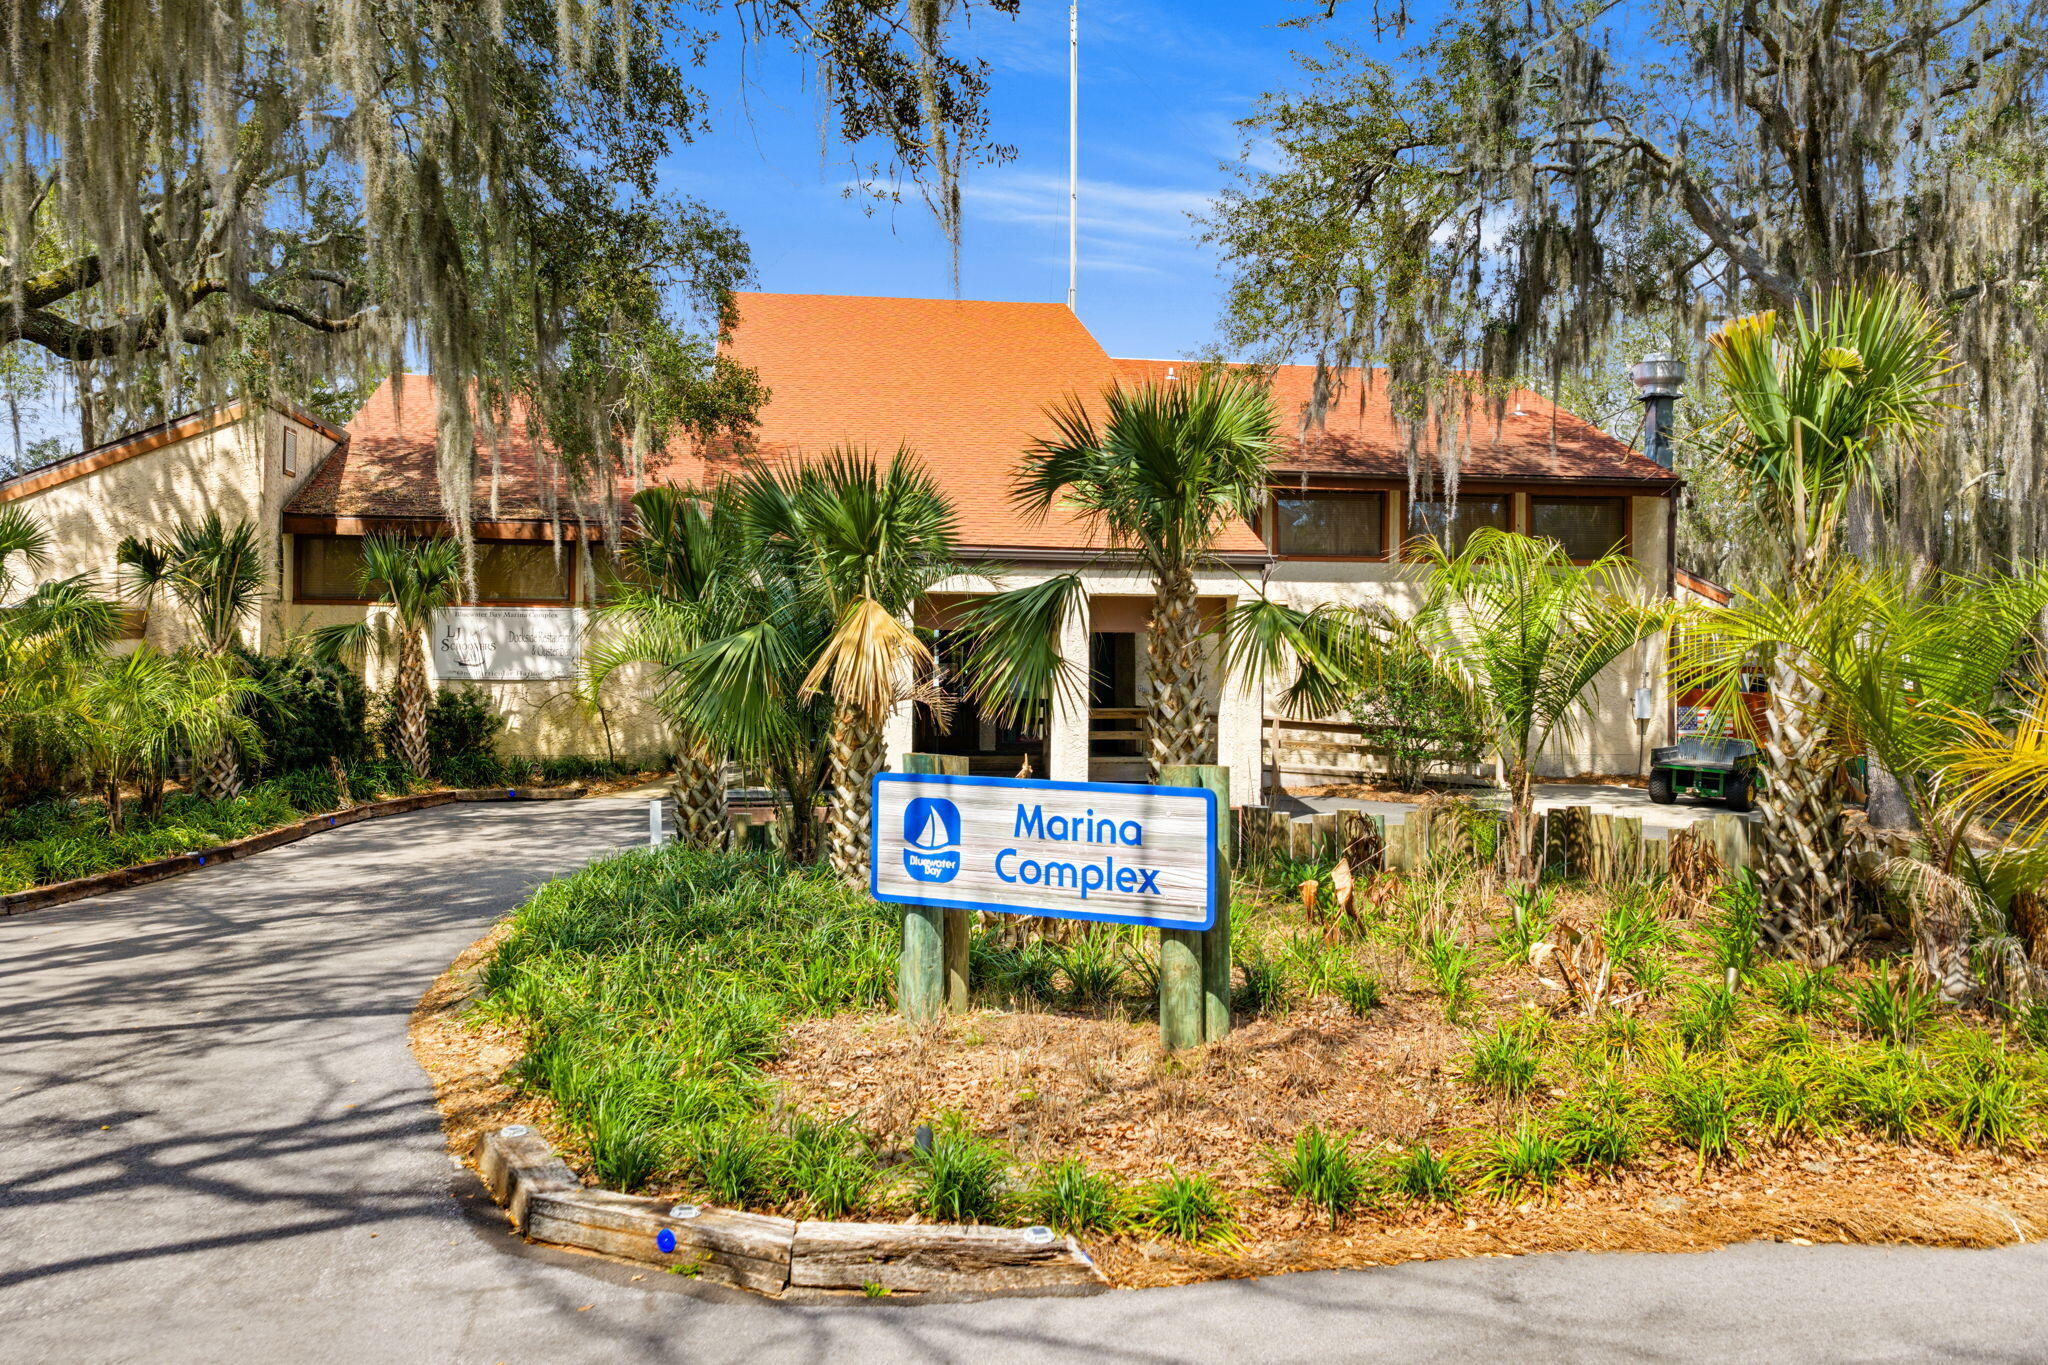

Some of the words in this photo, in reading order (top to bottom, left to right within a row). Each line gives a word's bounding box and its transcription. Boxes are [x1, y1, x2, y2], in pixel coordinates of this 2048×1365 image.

[489, 611, 502, 619] Bay
[528, 611, 558, 619] Complex
[1013, 803, 1142, 846] Marina
[910, 855, 956, 869] Bluewater
[924, 864, 942, 878] Bay
[995, 848, 1162, 899] Complex
